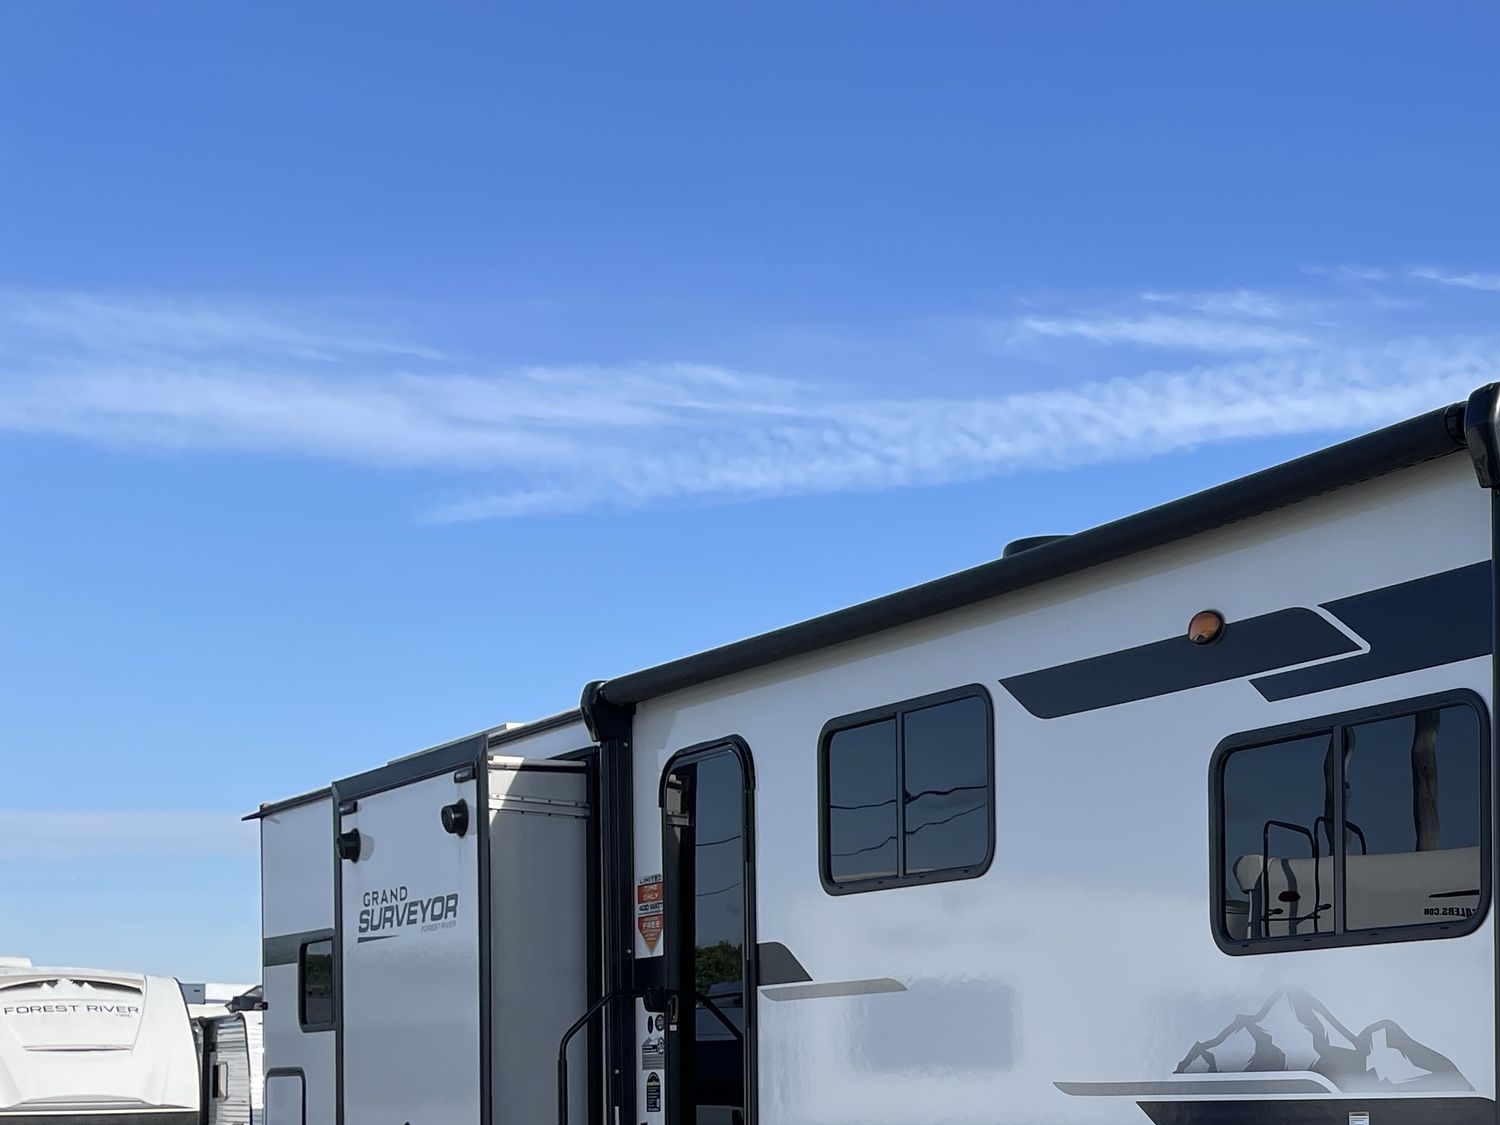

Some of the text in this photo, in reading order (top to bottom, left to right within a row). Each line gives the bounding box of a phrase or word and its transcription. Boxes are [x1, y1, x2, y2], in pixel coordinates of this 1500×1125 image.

[363, 886, 408, 907] GRAND
[358, 893, 459, 933] SURVEYOR
[4, 1004, 140, 1015] FOREST RIVER
